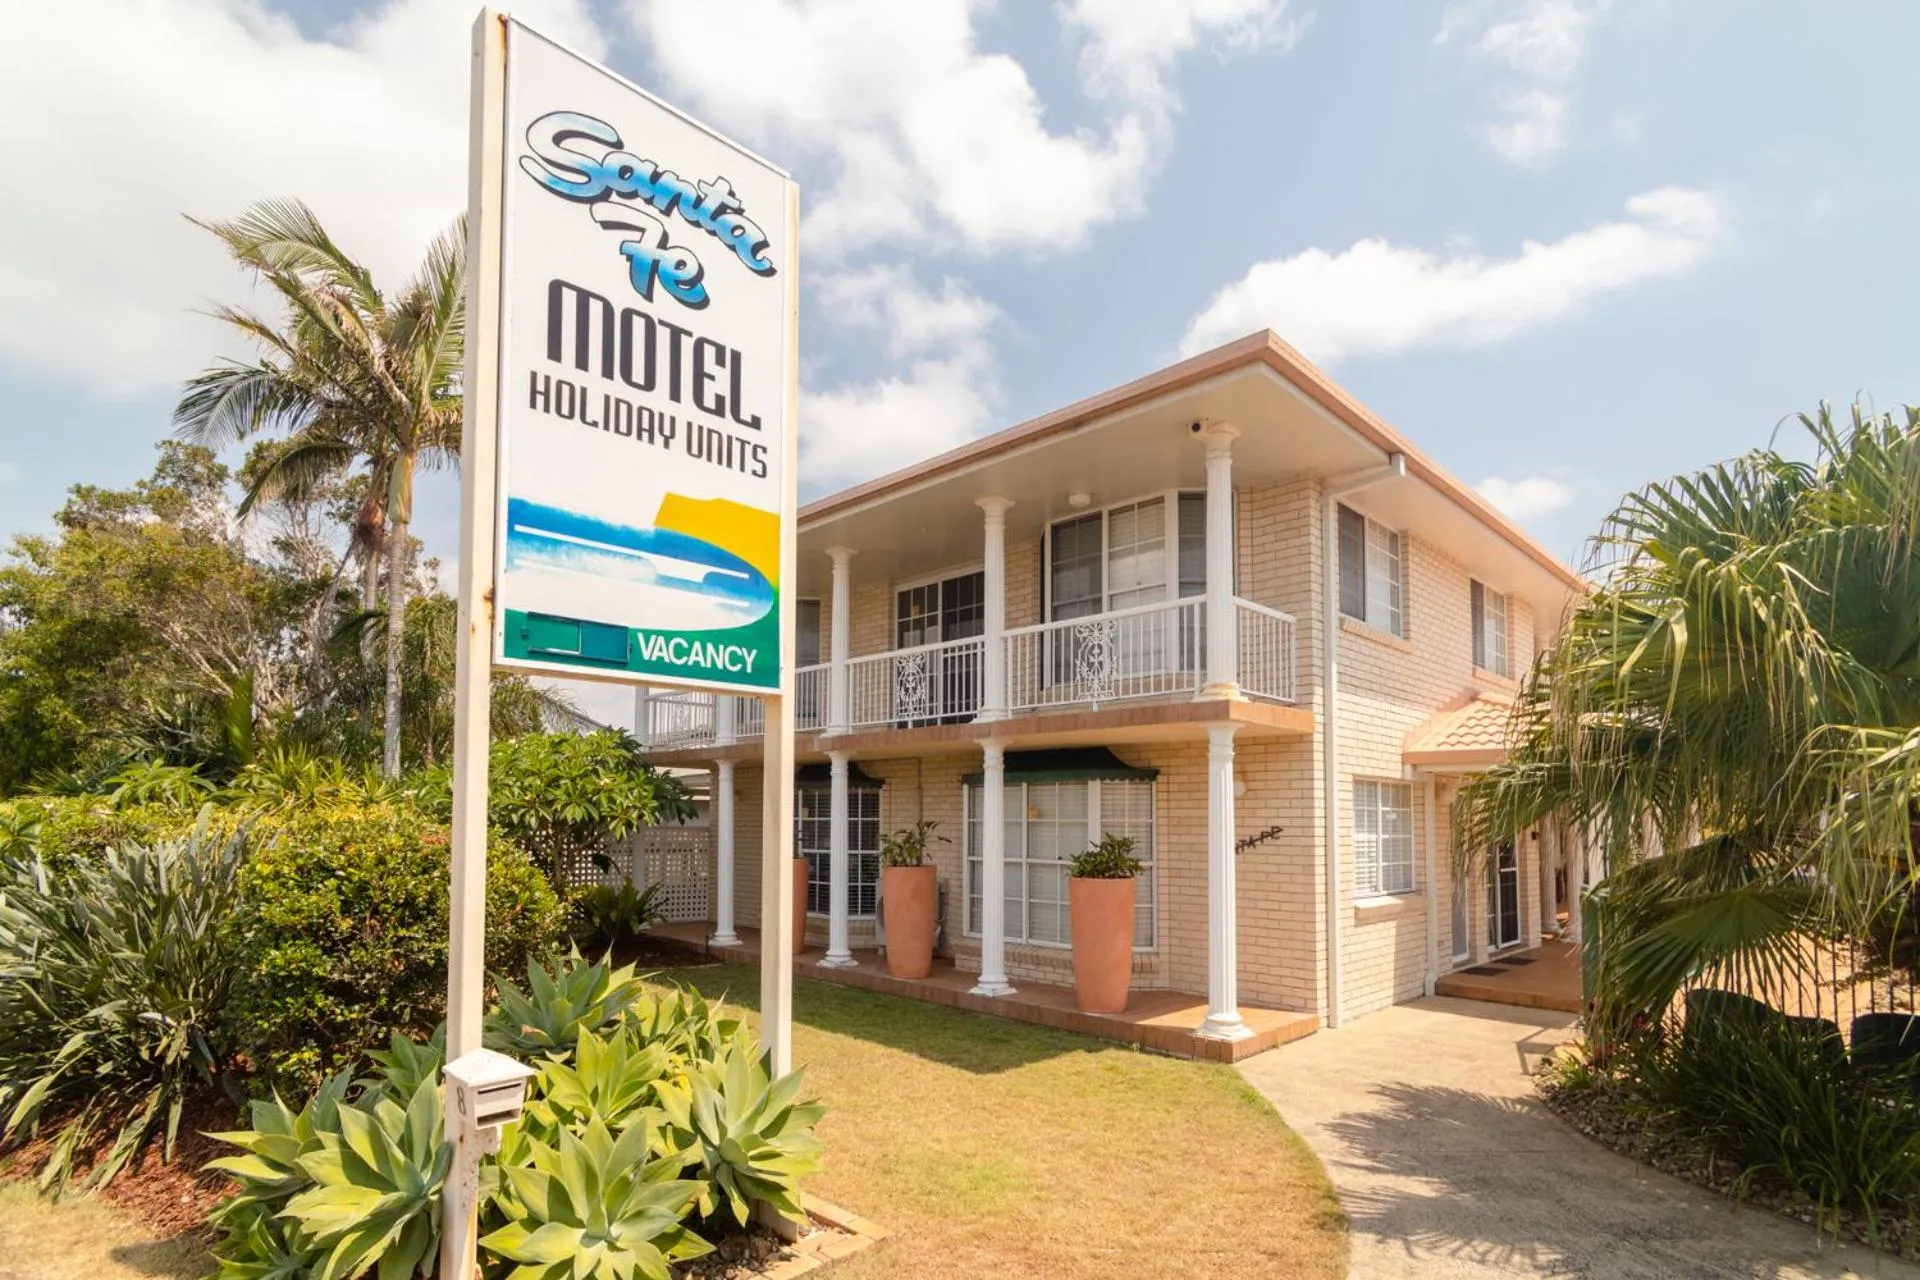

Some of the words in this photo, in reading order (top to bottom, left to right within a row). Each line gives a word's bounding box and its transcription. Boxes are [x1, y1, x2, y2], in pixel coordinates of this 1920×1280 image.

[519, 111, 777, 277] Santa
[590, 200, 710, 310] Fe
[547, 279, 762, 431] MOTEL
[529, 370, 676, 450] HOLIDAY
[686, 420, 768, 479] UNITS
[637, 632, 757, 673] VACANCY
[456, 1086, 467, 1116] 8
